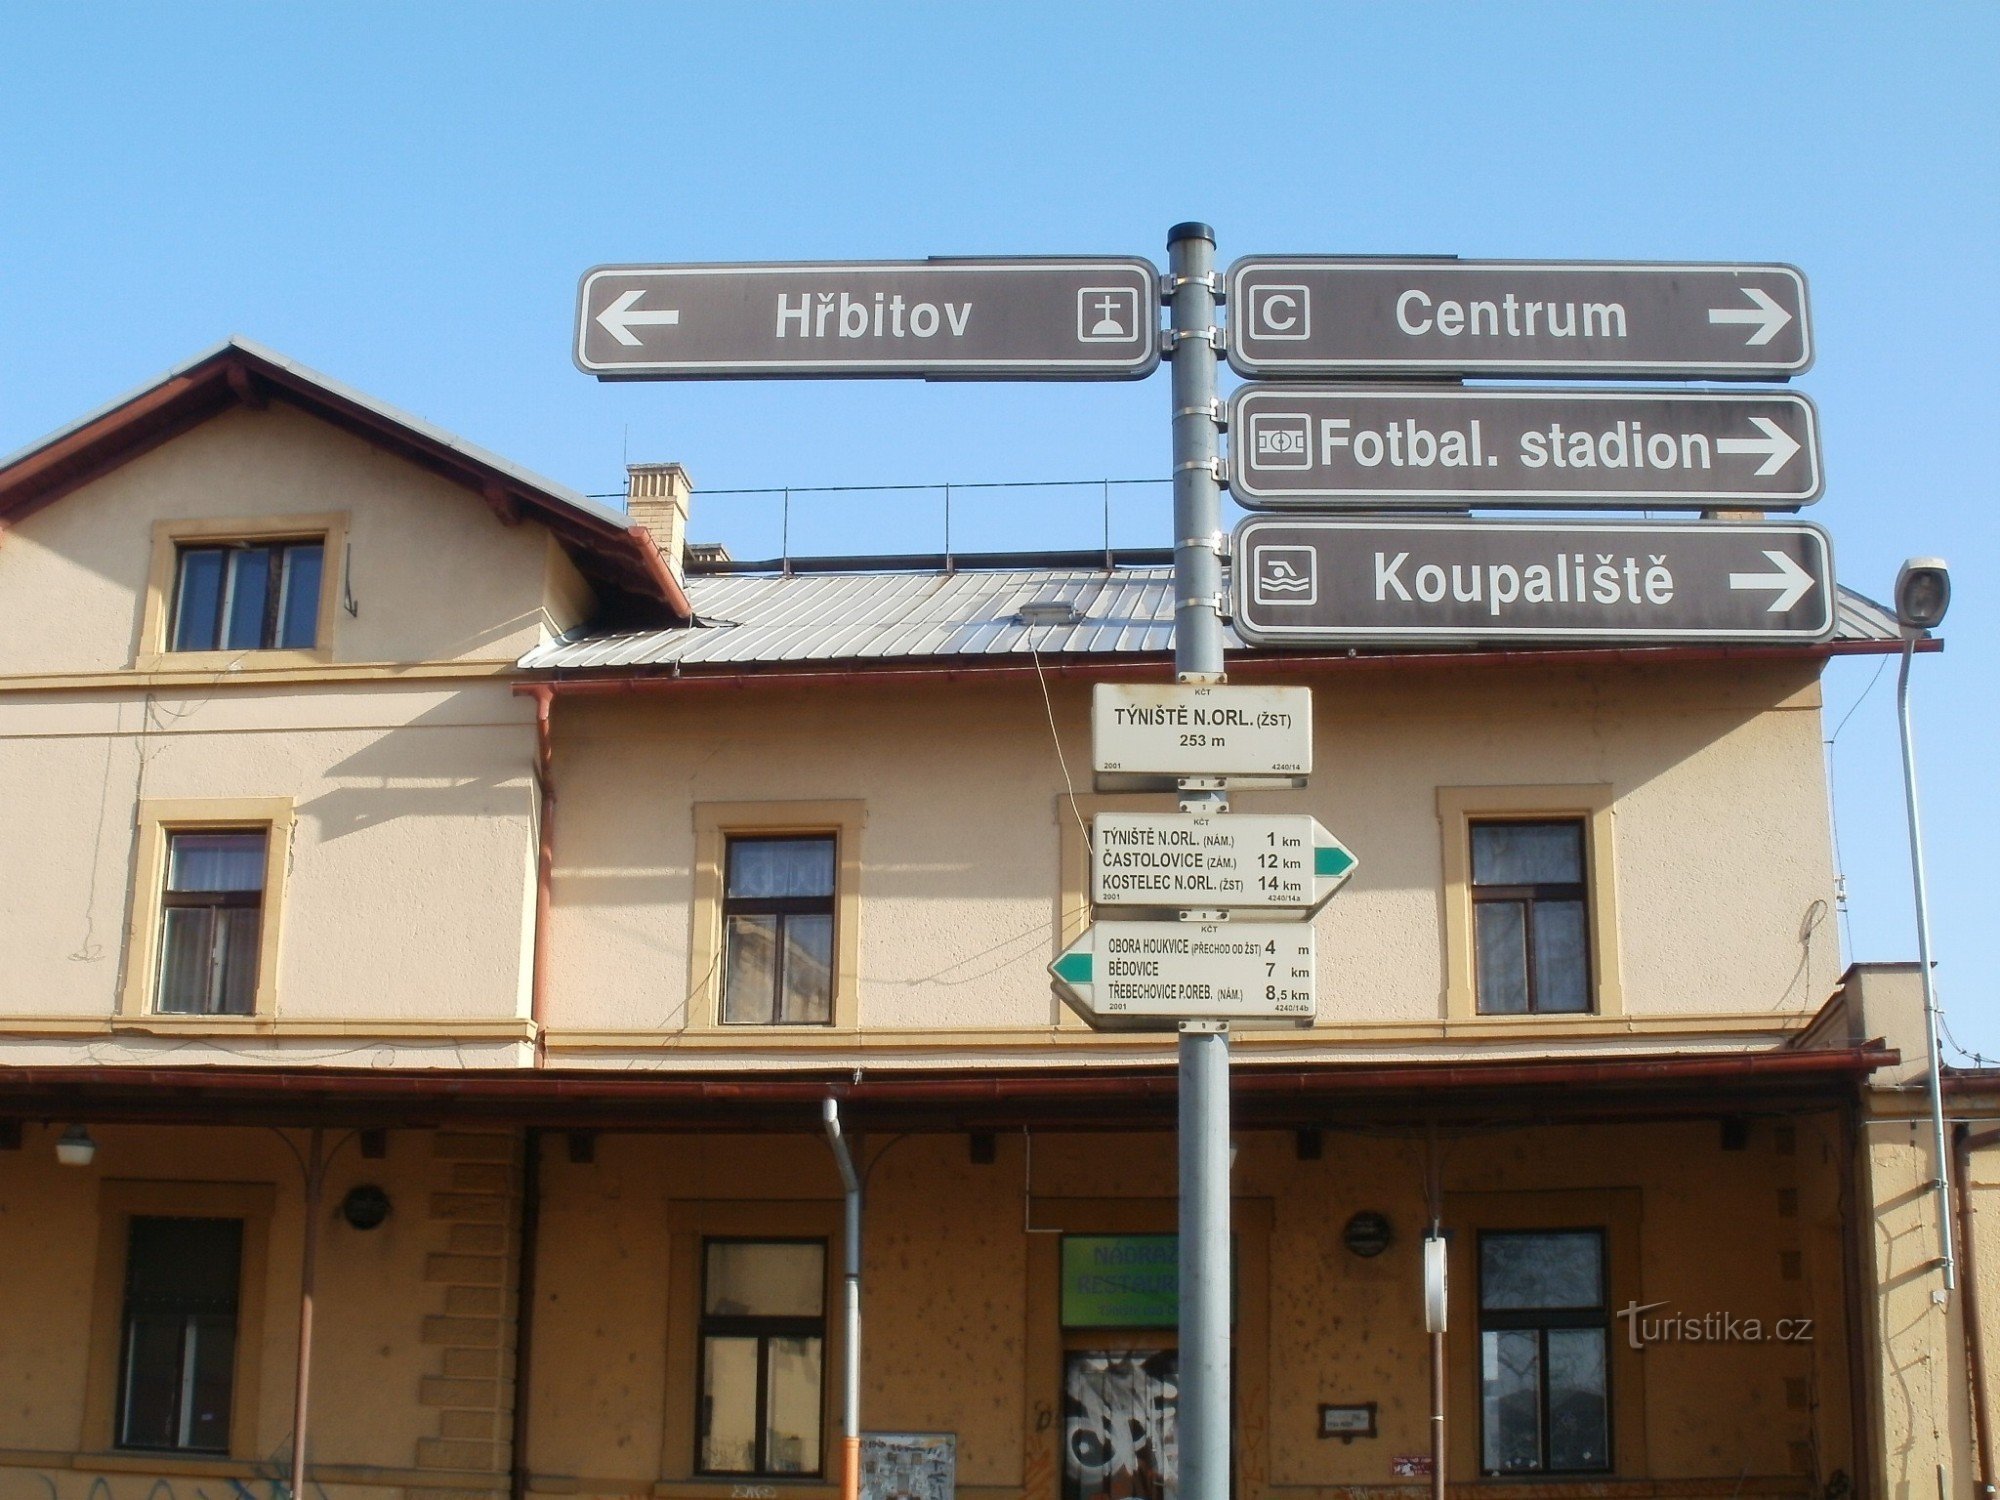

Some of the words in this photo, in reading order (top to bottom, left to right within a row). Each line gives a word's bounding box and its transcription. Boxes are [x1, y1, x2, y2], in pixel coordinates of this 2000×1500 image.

[776, 292, 973, 339] Hřbitov
[1263, 295, 1296, 330] C
[1397, 290, 1626, 337] Centrum
[1321, 419, 1497, 467] Fotbal.
[1520, 421, 1710, 469] stadion
[1375, 553, 1673, 615] Koupaliště
[1194, 687, 1211, 696] KČT
[1114, 704, 1188, 726] TÝNIŠTĚ
[1194, 709, 1254, 726] N.ORL.
[1256, 712, 1292, 730] (ŽST)
[1179, 734, 1207, 747] 253
[1211, 737, 1225, 747] m
[1103, 762, 1121, 770] 2001
[1271, 763, 1301, 771] 4240/14
[1193, 817, 1210, 826] KČT
[1102, 827, 1155, 846] TÝNIŠTĚ
[1158, 831, 1200, 846] N.ORL.
[1203, 834, 1235, 849] (NÁM.)
[1266, 832, 1275, 847] 1
[1282, 836, 1301, 847] km
[1102, 849, 1204, 868] ČASTOLOVICE
[1206, 856, 1237, 871] (ZÁM.)
[1257, 854, 1278, 869] 12
[1282, 858, 1301, 869] km
[1102, 875, 1171, 890] KOSTELEC
[1174, 875, 1217, 890] N.ORL.
[1219, 878, 1244, 893] (ŽST)
[1258, 876, 1279, 891] 14
[1283, 880, 1301, 891] km
[1102, 893, 1120, 901] 2001
[1267, 894, 1301, 902] 4240/14a
[1200, 924, 1218, 933] KČT
[1108, 939, 1142, 954] OBORA
[1143, 939, 1189, 954] HOUKVICE
[1191, 942, 1231, 956] (PŘECHOD
[1231, 943, 1244, 955] OD
[1244, 942, 1262, 957] ŽST)
[1264, 940, 1276, 955] 4
[1108, 958, 1159, 977] BĚDOVICE
[1265, 963, 1276, 978] 7
[1291, 966, 1310, 978] km
[1108, 981, 1177, 1000] TŘEBECHOVICE
[1178, 985, 1213, 1000] P.OREB.
[1217, 987, 1243, 1003] (NÁM.)
[1265, 985, 1288, 1002] 8,5
[1291, 989, 1310, 1001] km
[1109, 1002, 1127, 1010] 2001
[1274, 1004, 1309, 1012] 4240/14b
[1077, 1274, 1177, 1294] RESTAUR
